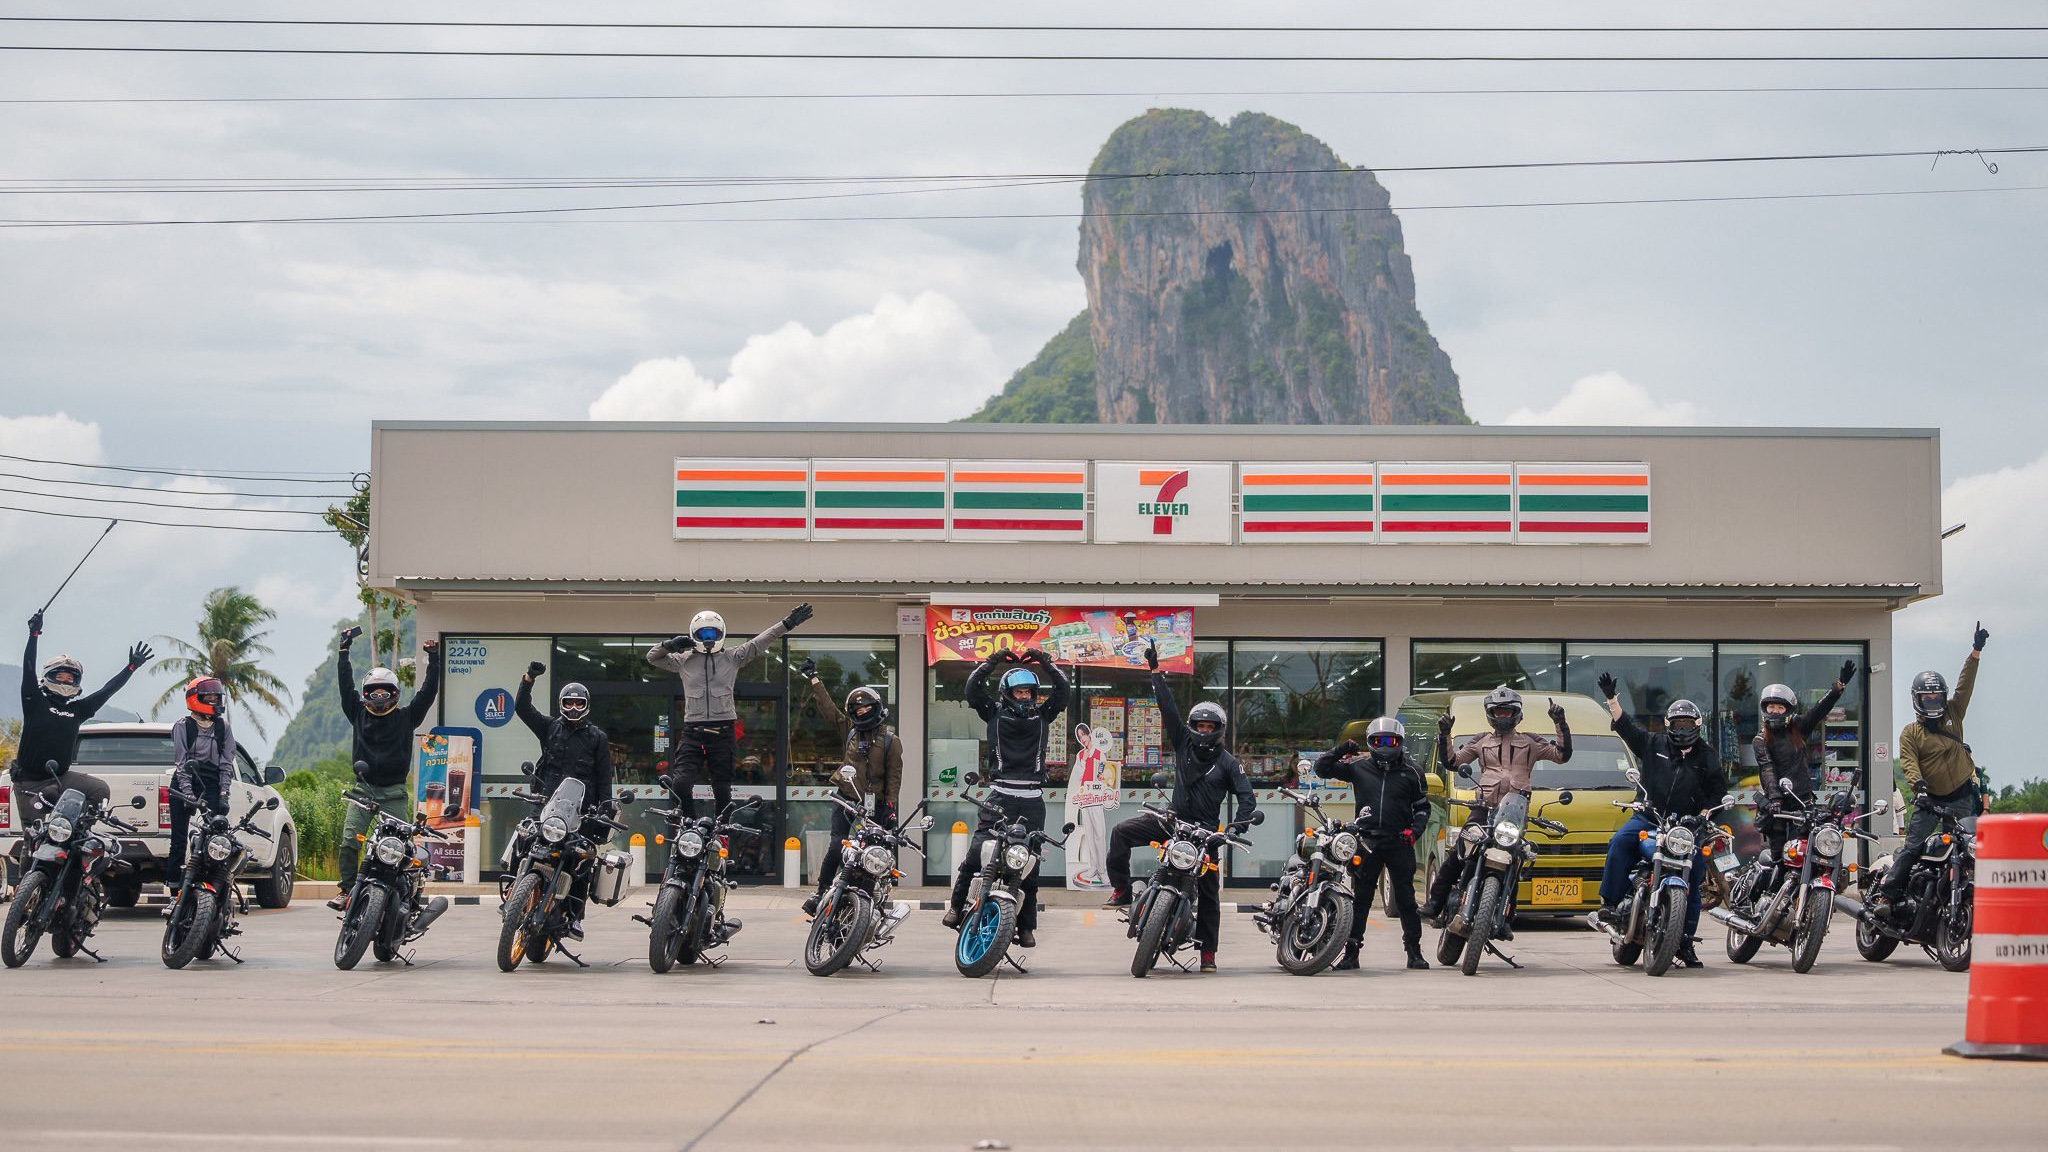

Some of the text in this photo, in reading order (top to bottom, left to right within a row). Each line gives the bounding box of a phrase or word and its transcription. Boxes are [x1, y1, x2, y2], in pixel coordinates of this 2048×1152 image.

[1140, 469, 1188, 535] 7
[974, 609, 1052, 624] ยกทัพสินค้า
[449, 647, 487, 657] 22470
[1991, 870, 2048, 884] กรมทาง
[1536, 885, 1579, 896] 30-4720
[1995, 944, 2048, 957] แขวงทาง
